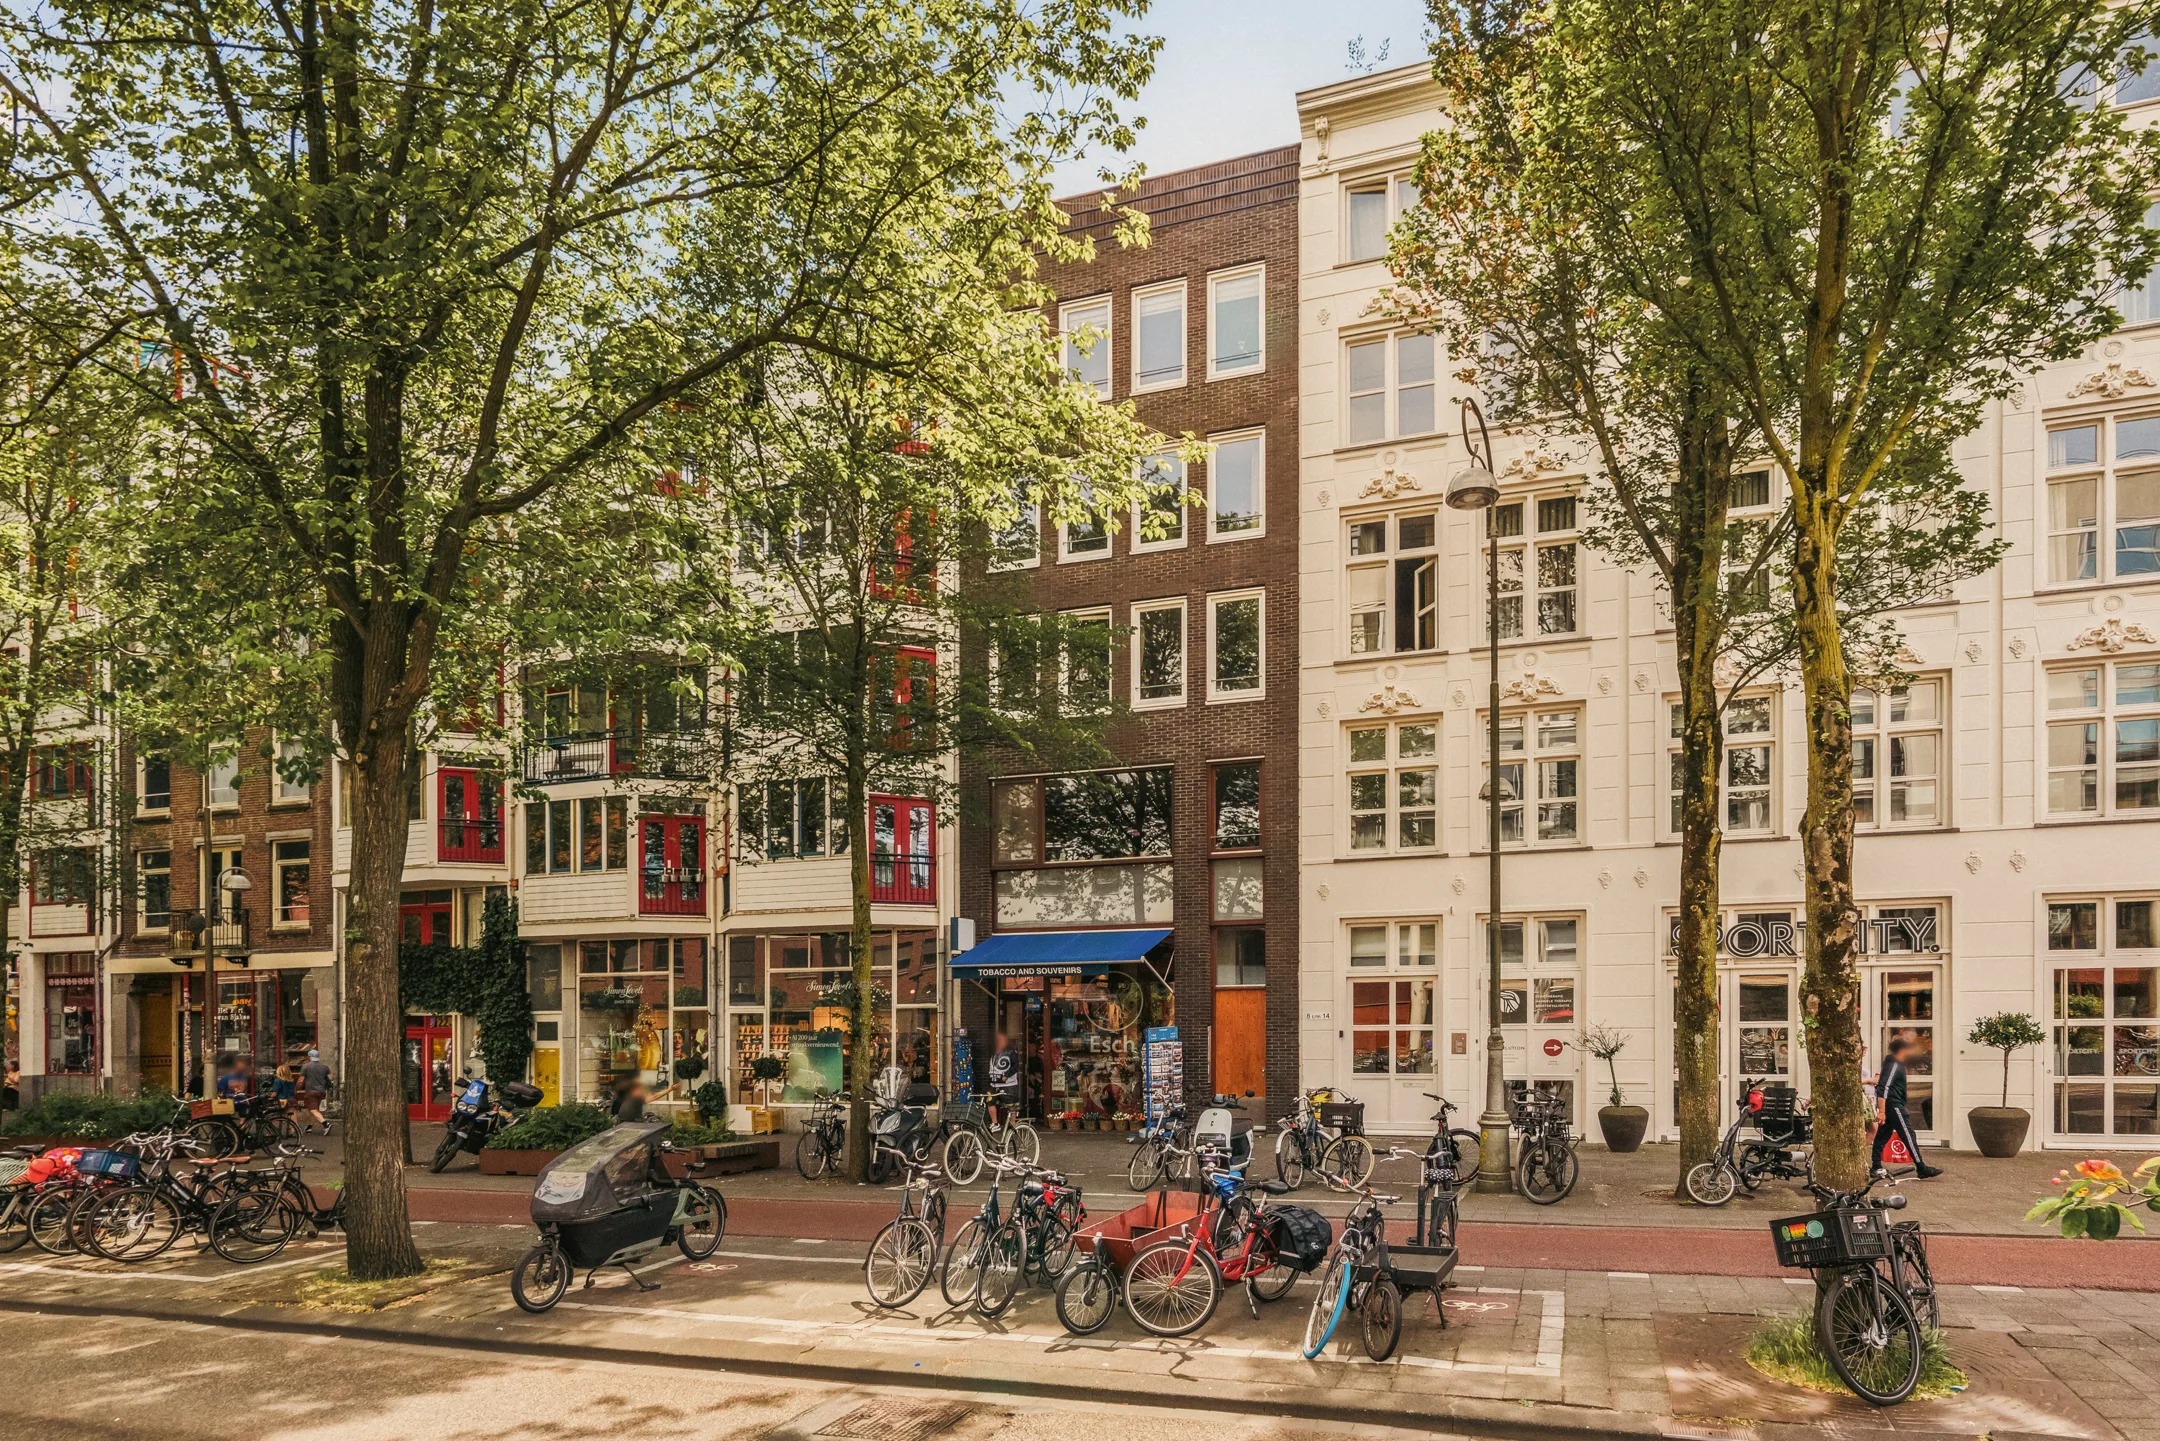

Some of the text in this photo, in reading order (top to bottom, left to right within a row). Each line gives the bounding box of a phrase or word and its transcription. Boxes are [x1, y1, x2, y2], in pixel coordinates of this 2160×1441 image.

[978, 966, 1082, 976] TOBACCO AND SOUVENIRS
[1089, 1035, 1135, 1053] Esch
